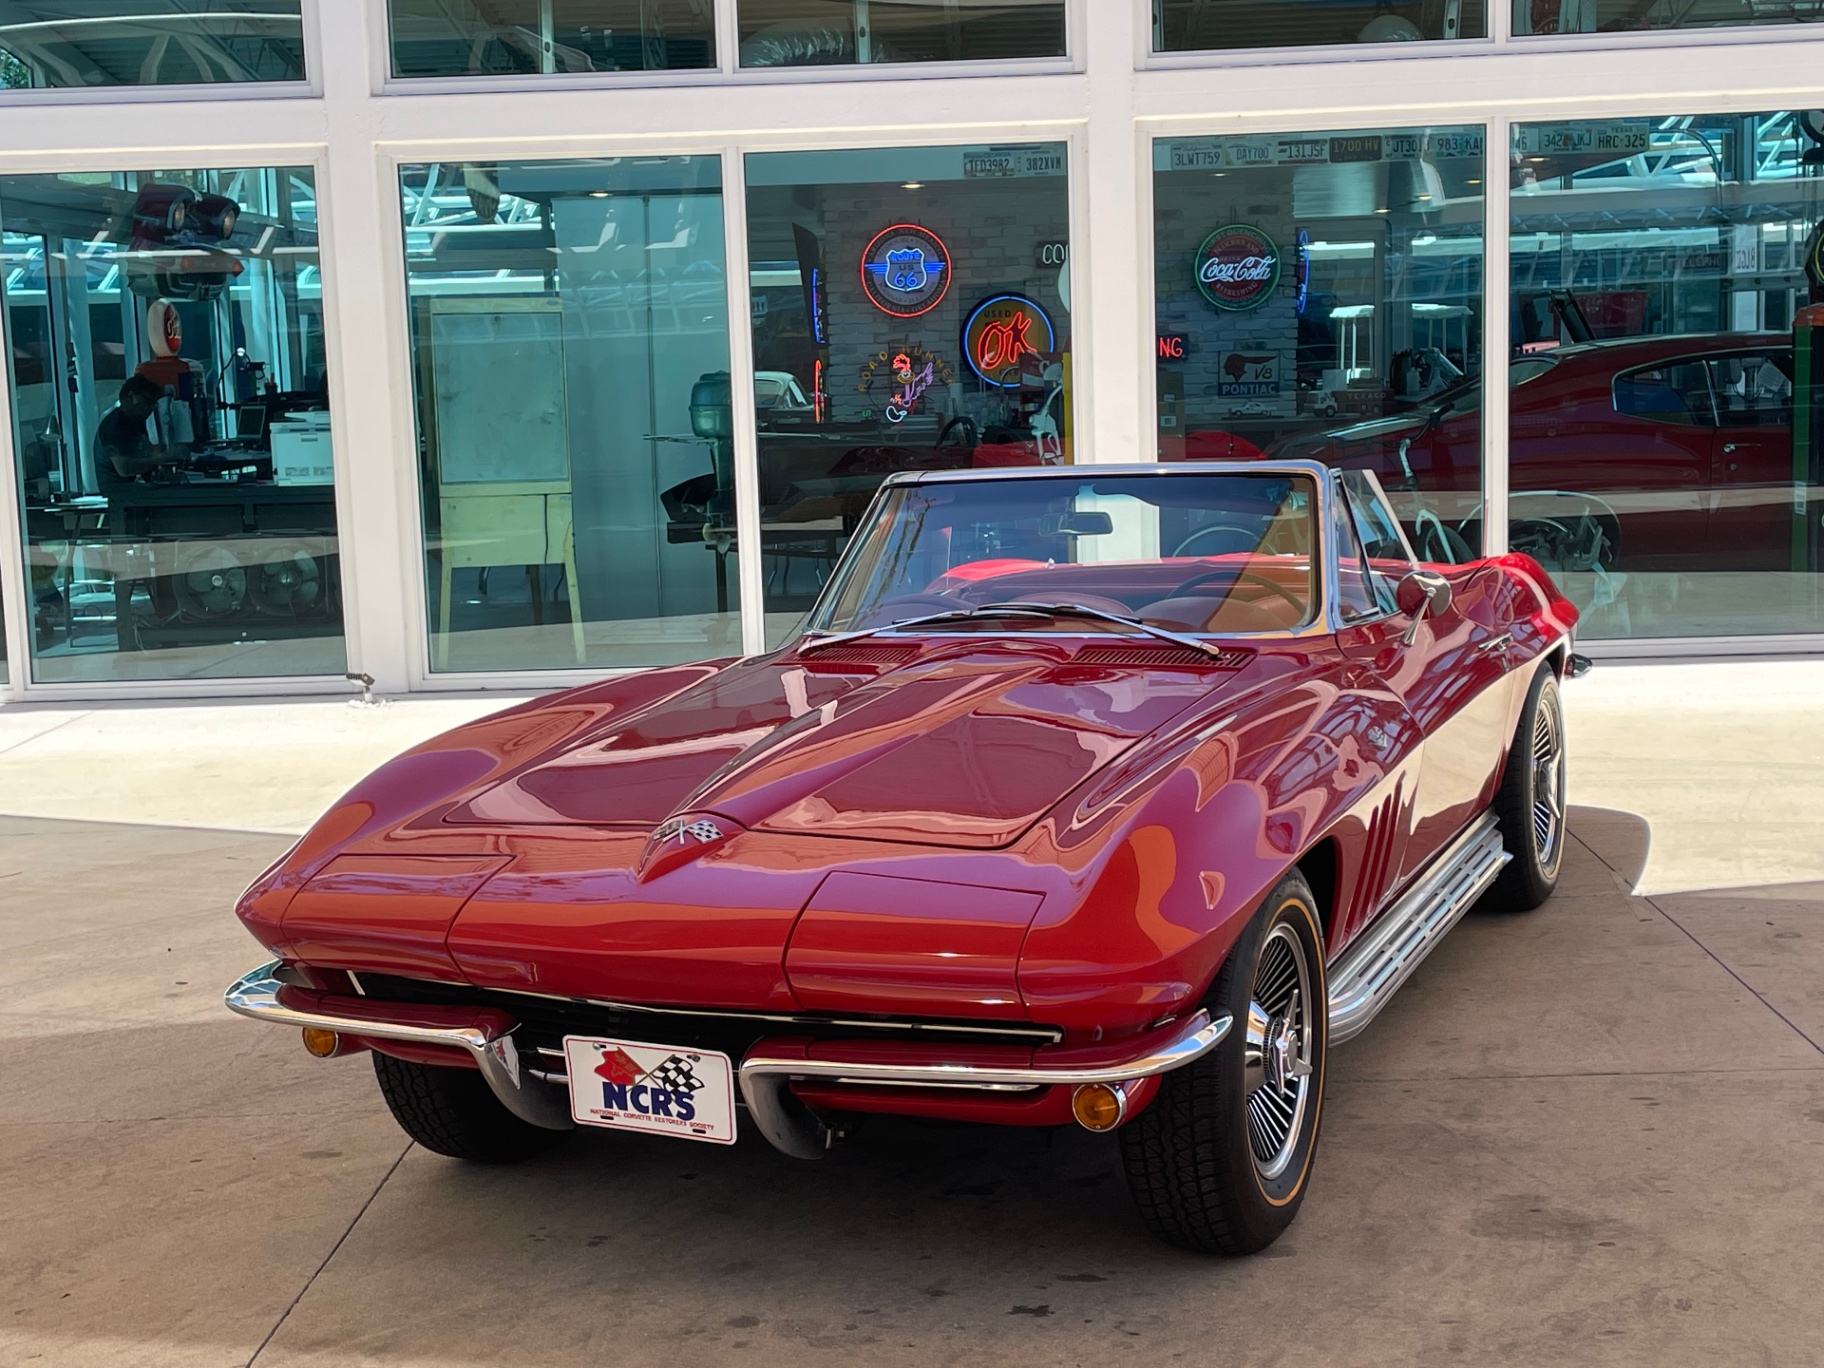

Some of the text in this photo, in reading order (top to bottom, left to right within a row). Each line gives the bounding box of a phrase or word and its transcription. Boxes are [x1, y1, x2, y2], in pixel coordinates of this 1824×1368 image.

[1334, 139, 1362, 152] 1700
[1437, 136, 1483, 151] 983 KA
[1544, 134, 1561, 148] 342
[1598, 133, 1646, 149] HRC 325
[1174, 151, 1221, 166] 3LWT759
[891, 252, 920, 261] ROUTE
[894, 271, 918, 288] 66
[984, 309, 1011, 318] USED
[977, 311, 1038, 370] OK
[1255, 365, 1273, 381] V8
[1222, 383, 1276, 395] PONTIAC
[1347, 392, 1387, 400] TEXACO
[602, 1081, 696, 1121] NCRS
[589, 1108, 715, 1131] NATIONAL CORVETTE RESTORERS SOCIETY
